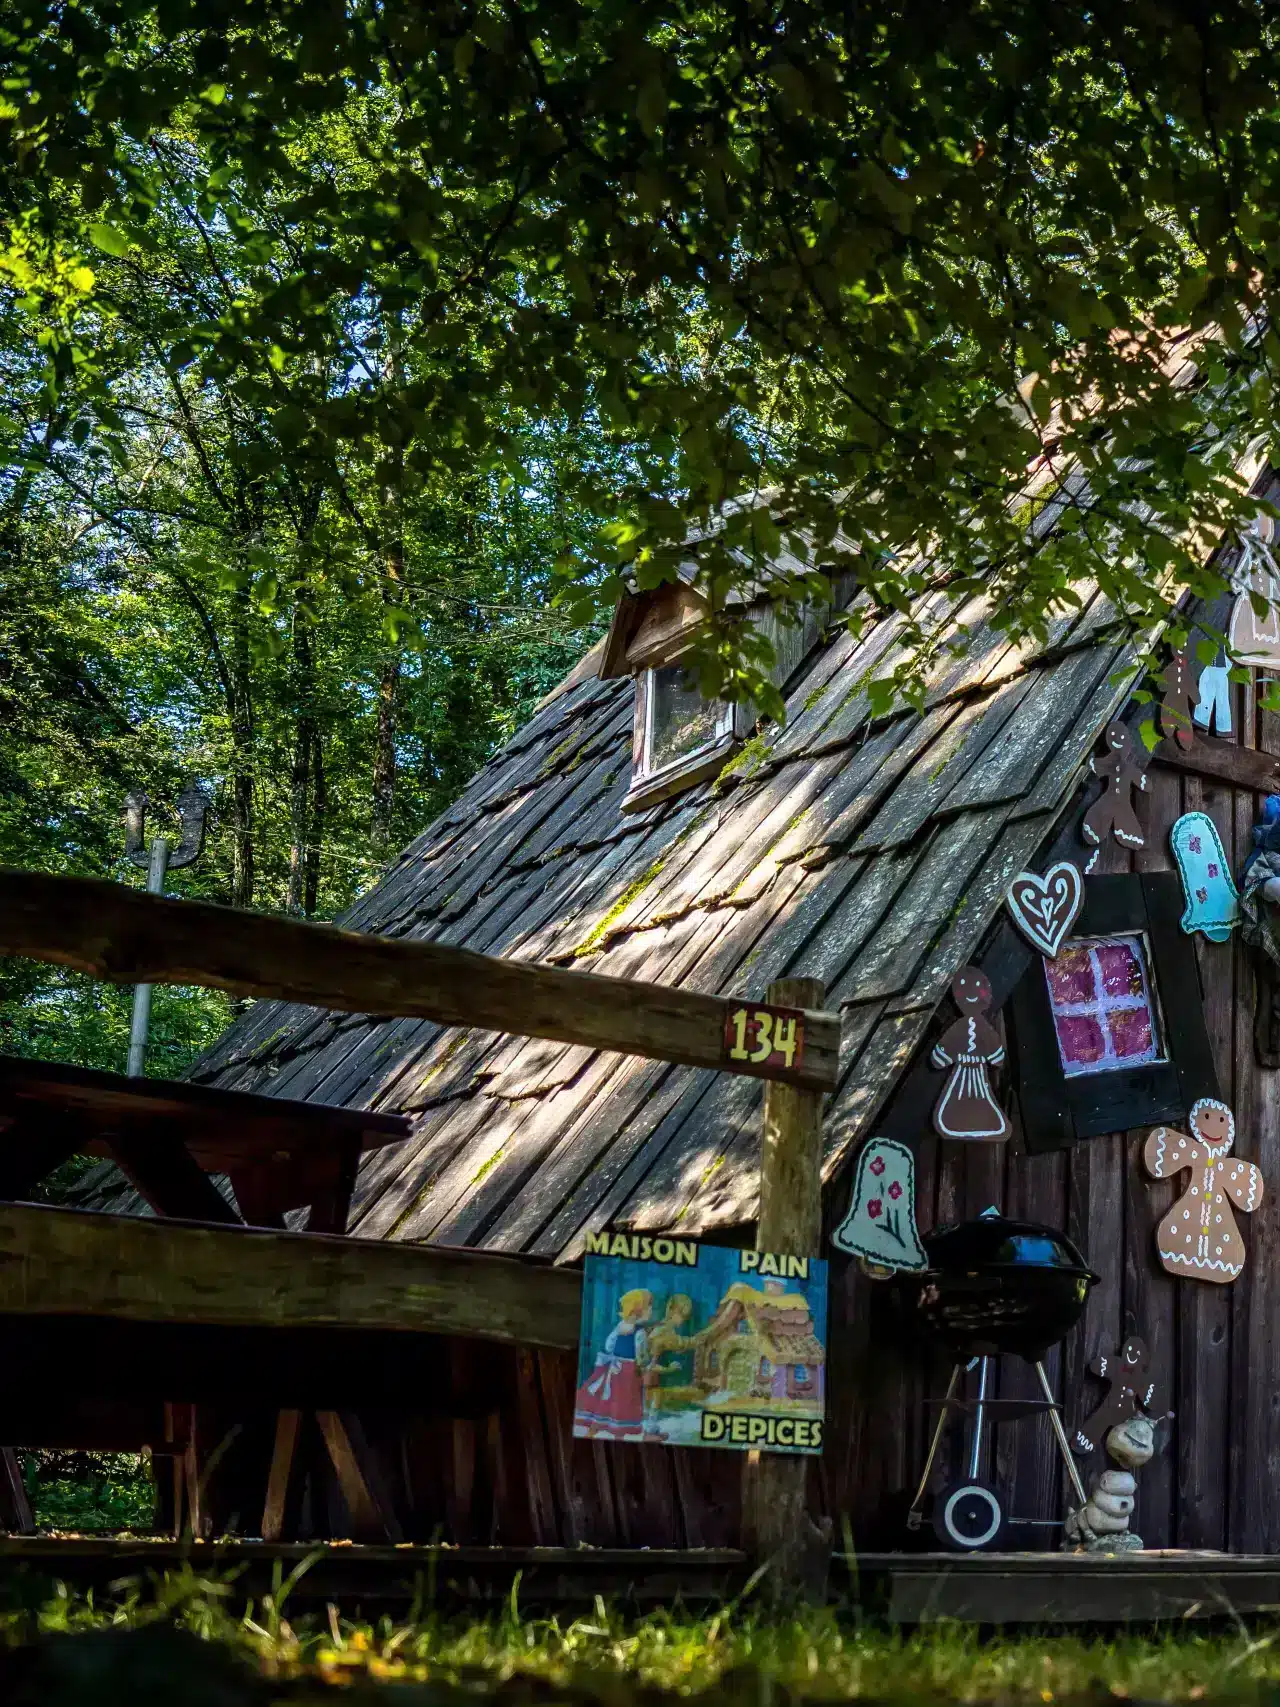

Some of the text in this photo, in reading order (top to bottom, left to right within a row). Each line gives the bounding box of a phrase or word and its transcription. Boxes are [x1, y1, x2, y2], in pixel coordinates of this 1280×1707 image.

[730, 1008, 797, 1068] 134
[585, 1231, 808, 1279] MAISON PAIN
[702, 1414, 823, 1447] D'EPICES
